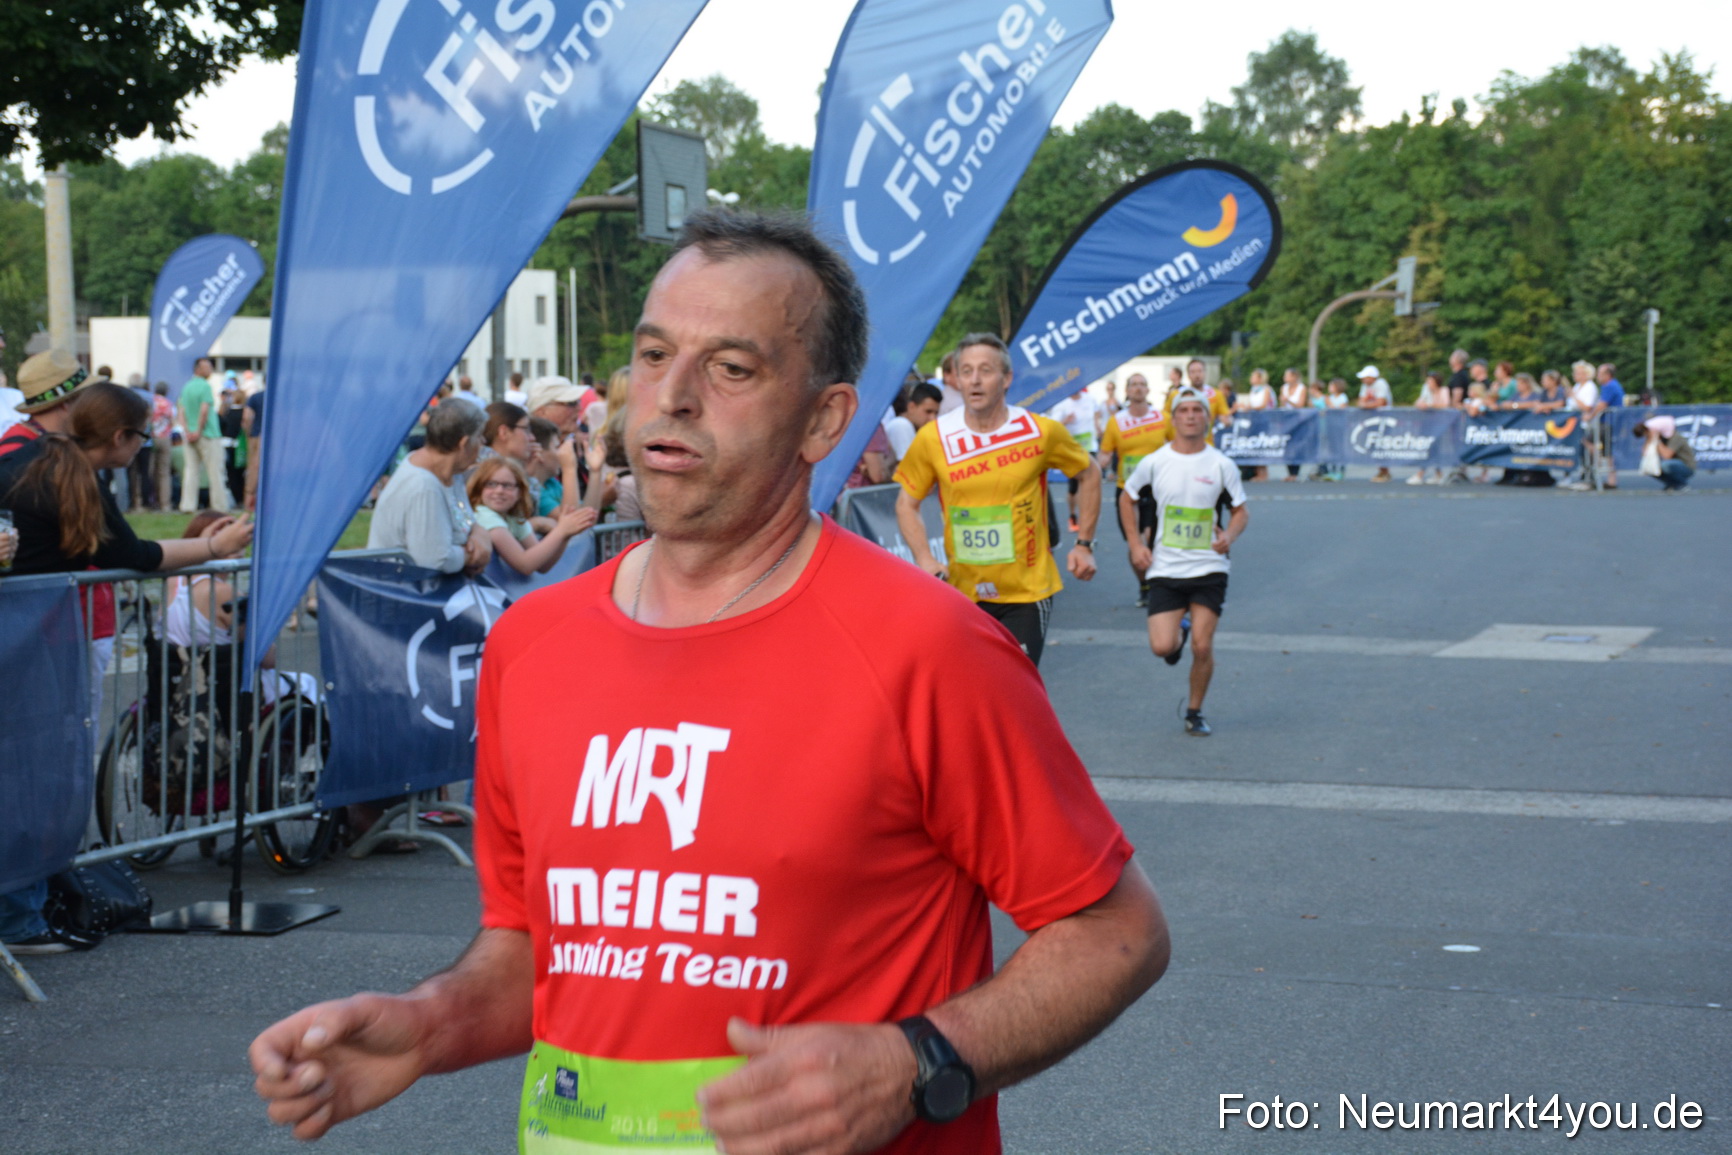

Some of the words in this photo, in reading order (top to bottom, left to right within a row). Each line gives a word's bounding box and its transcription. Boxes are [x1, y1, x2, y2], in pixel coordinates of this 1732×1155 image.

[524, 0, 626, 133] AUTO
[175, 252, 239, 336] Fischer
[1019, 251, 1201, 368] Frischmann
[1135, 286, 1180, 321] Druck
[1208, 238, 1264, 281] Medien
[949, 460, 992, 483] MAX
[996, 445, 1044, 468] BÖGL
[1220, 431, 1292, 450] Fischer
[1364, 431, 1435, 450] Fischer
[963, 528, 1000, 549] 850
[1173, 524, 1202, 539] 410
[571, 721, 731, 851] MRT
[546, 868, 759, 937] MEIER
[548, 934, 649, 981] unning
[655, 943, 788, 990] Team
